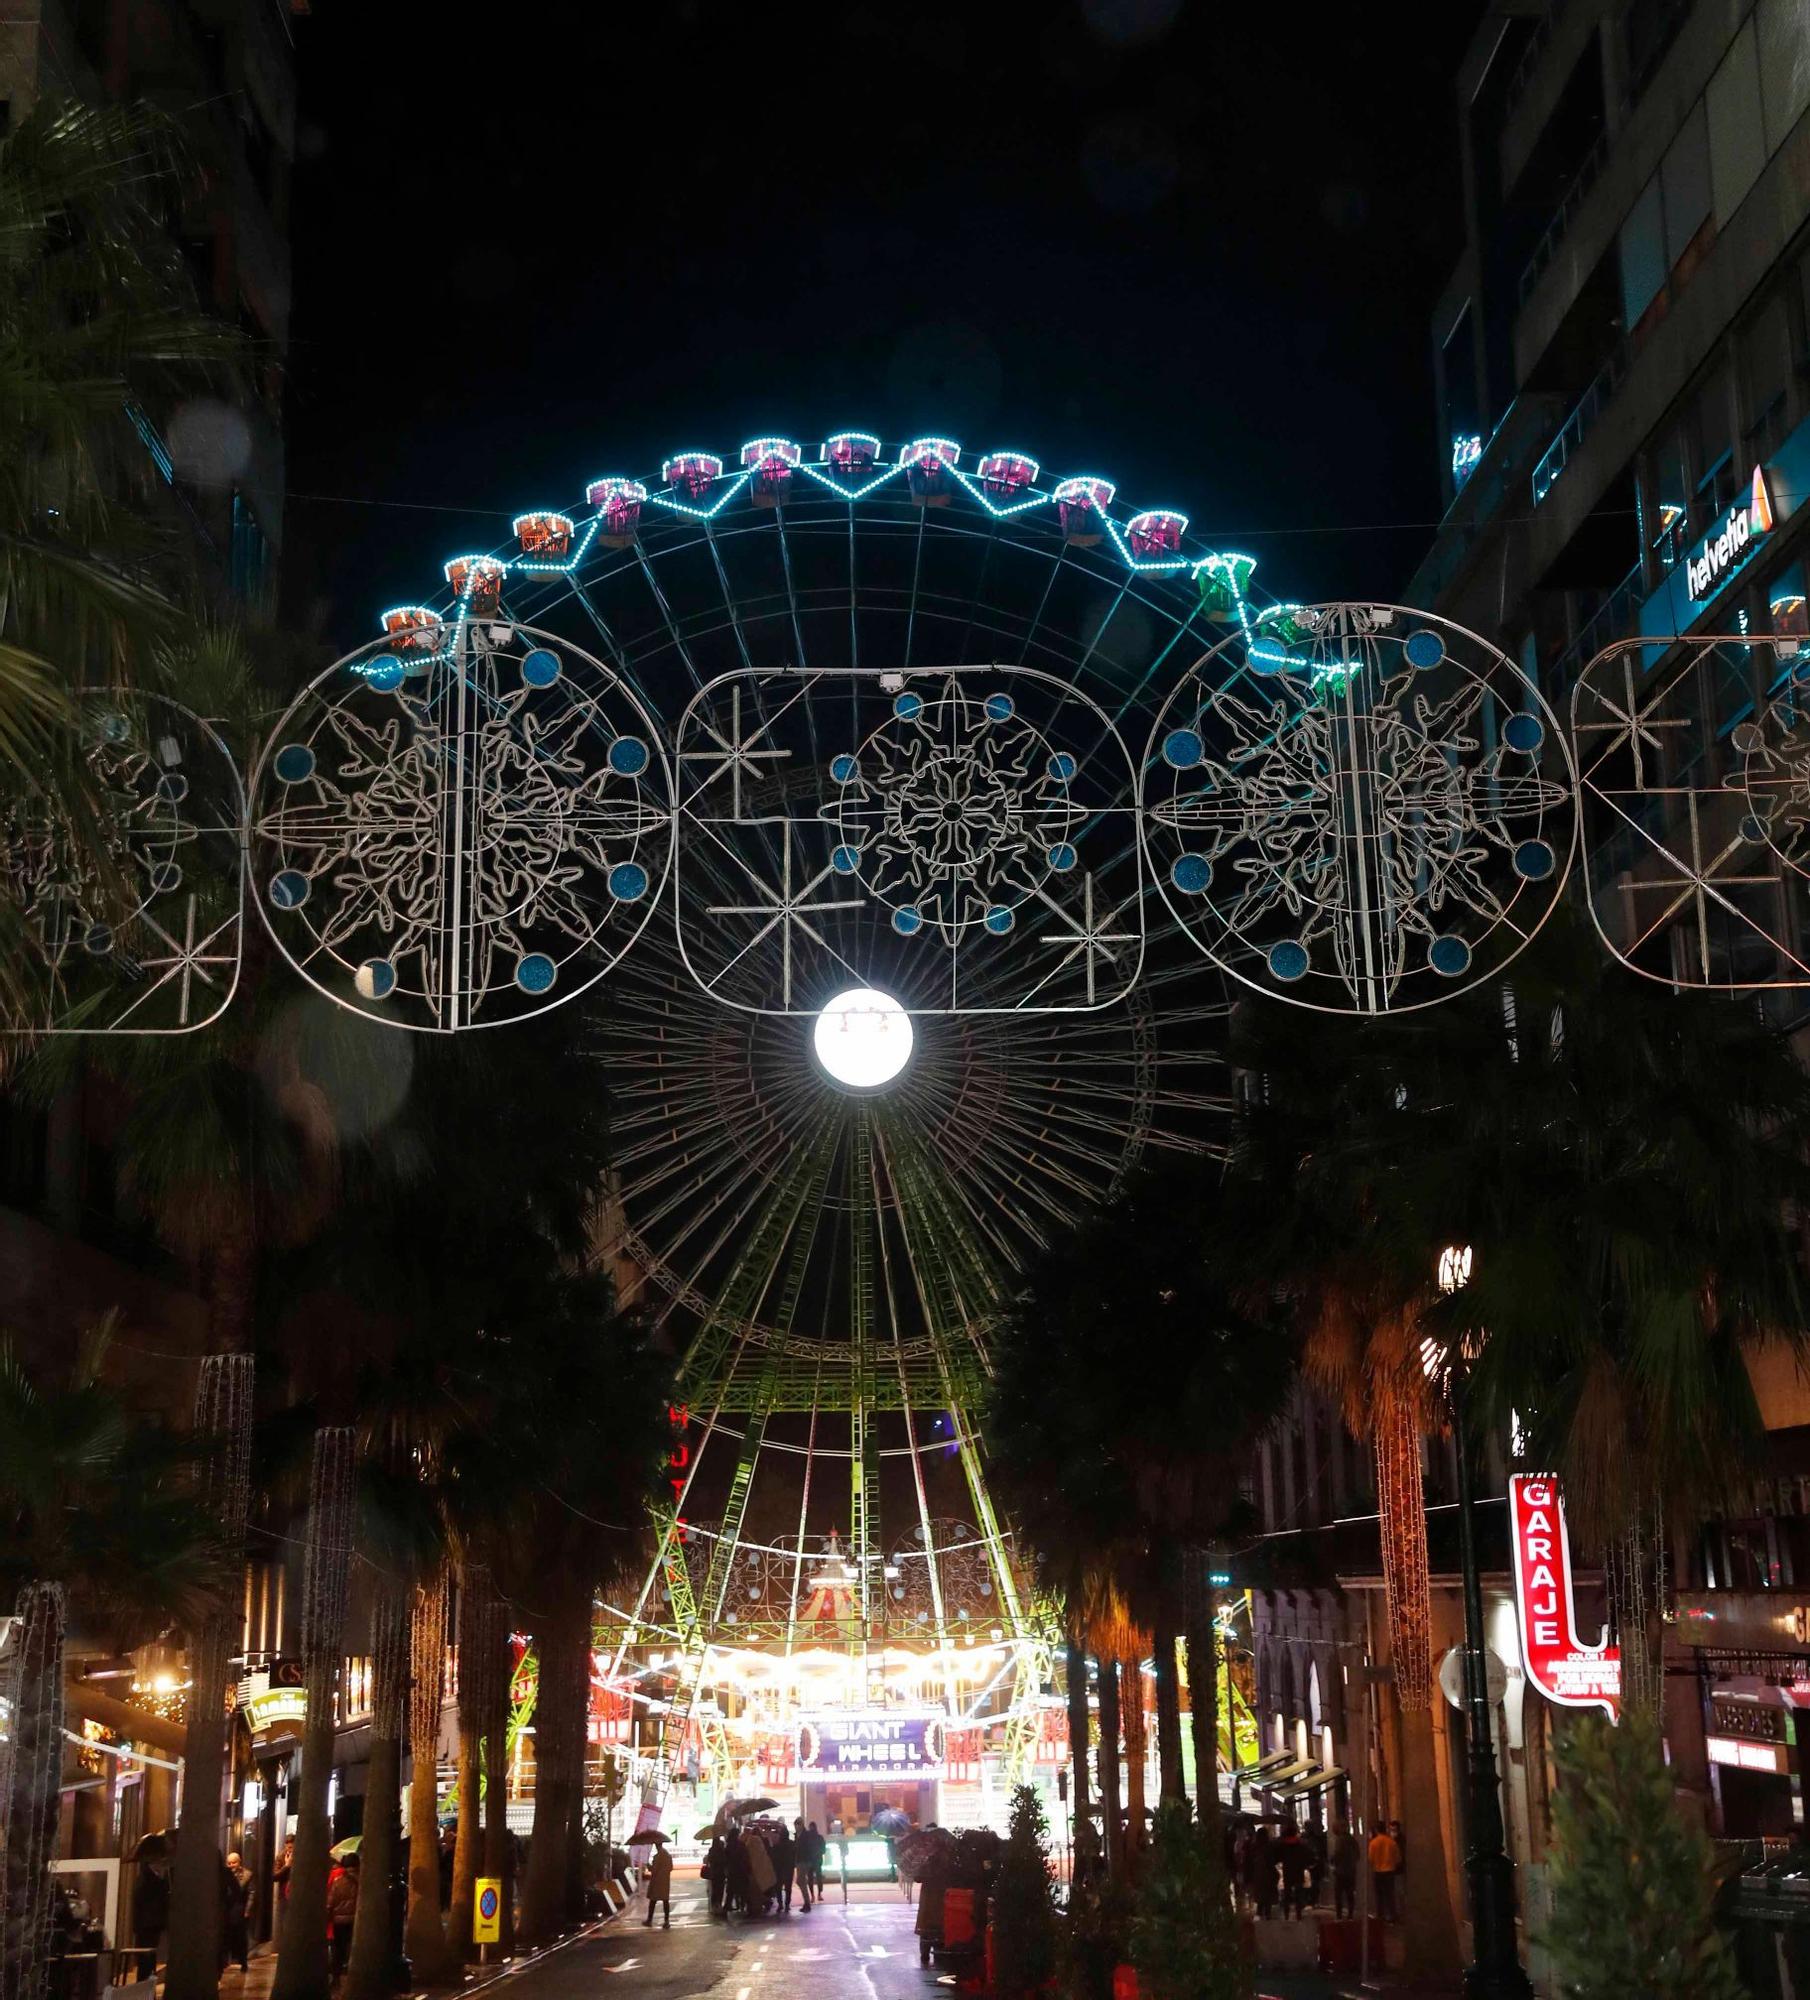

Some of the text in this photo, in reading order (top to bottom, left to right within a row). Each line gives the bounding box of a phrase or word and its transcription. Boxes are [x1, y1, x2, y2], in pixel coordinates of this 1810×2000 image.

[1686, 507, 1749, 602] helvetia
[1522, 1483, 1561, 1646] GARAJE
[830, 1721, 906, 1740] GIANT
[838, 1743, 922, 1762] WHEEL
